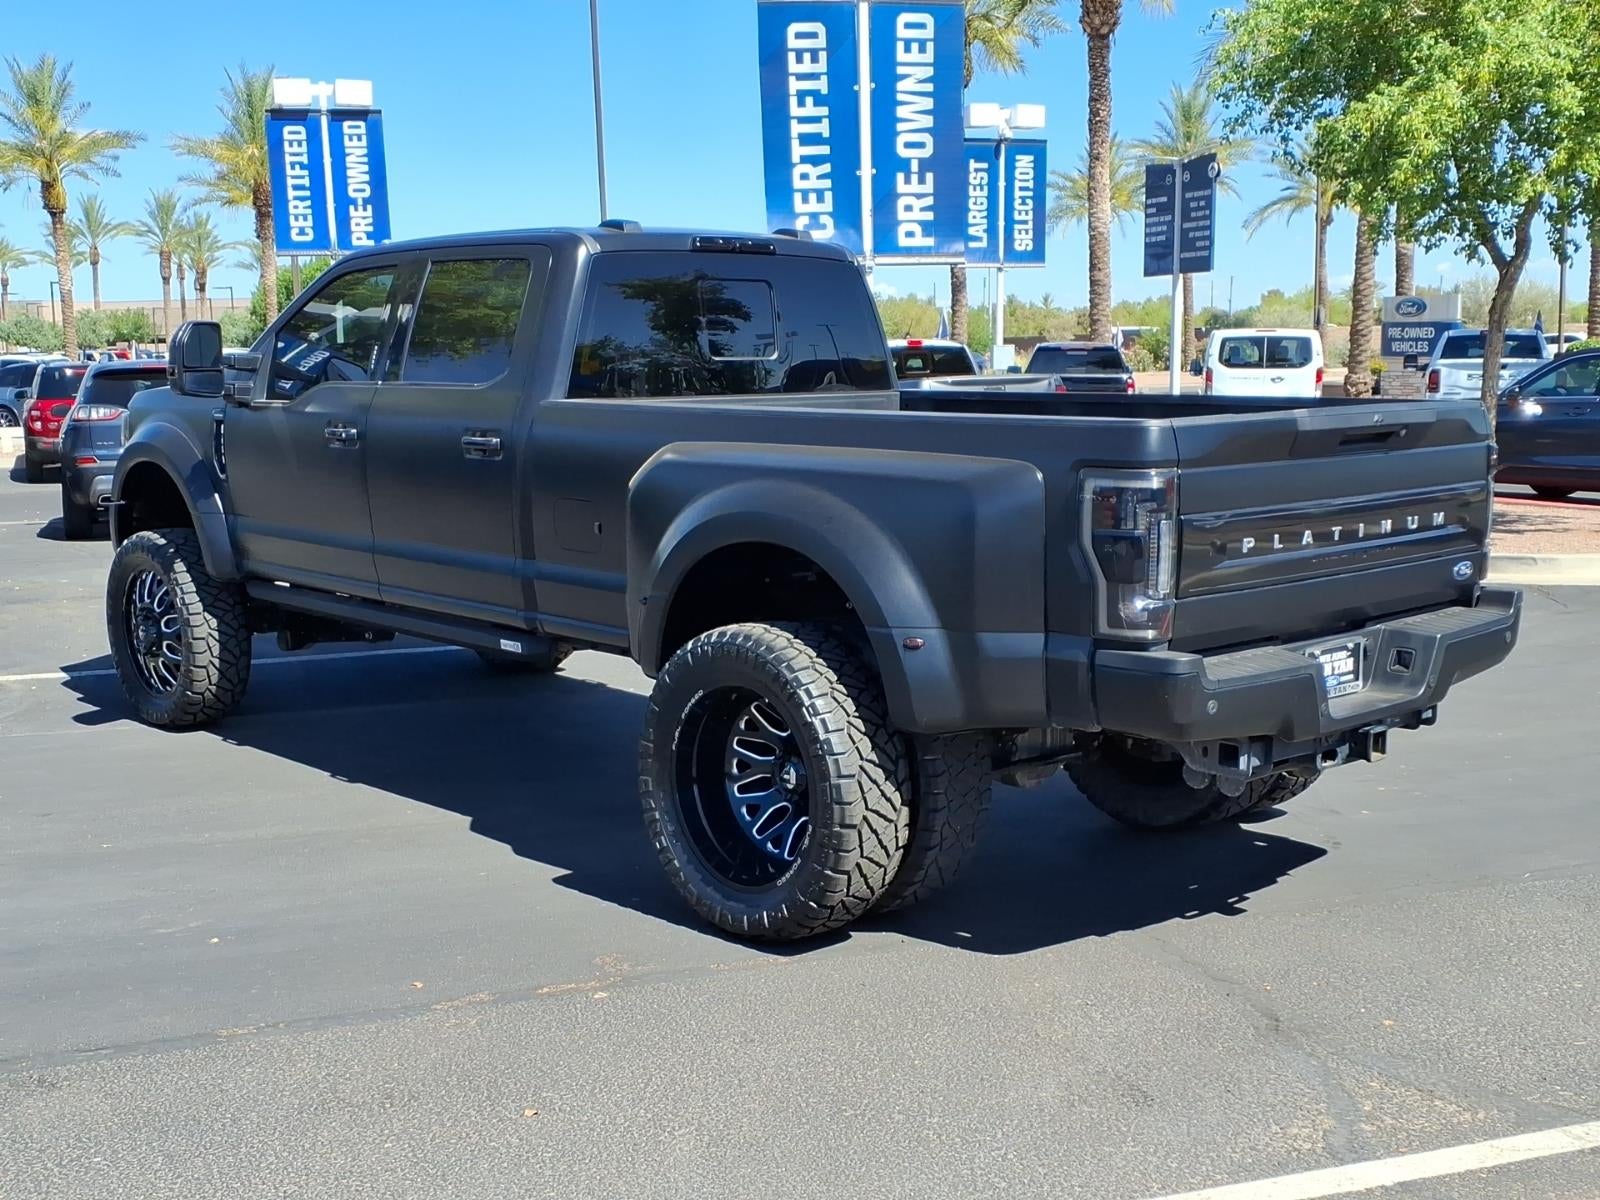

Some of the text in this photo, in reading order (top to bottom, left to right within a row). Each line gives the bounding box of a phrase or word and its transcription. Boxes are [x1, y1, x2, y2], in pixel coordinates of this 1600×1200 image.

[787, 22, 835, 240] CERTIFIED
[896, 12, 935, 247] PRE-OWNED
[283, 125, 314, 242] CERTIFIED
[342, 120, 375, 246] PRE-OWNED
[968, 158, 989, 248] LARGEST
[1013, 154, 1035, 252] SELECTION
[1388, 327, 1435, 338] PRE-OWNED
[1391, 341, 1429, 353] VEHICLES
[1242, 511, 1445, 553] PLATINUM
